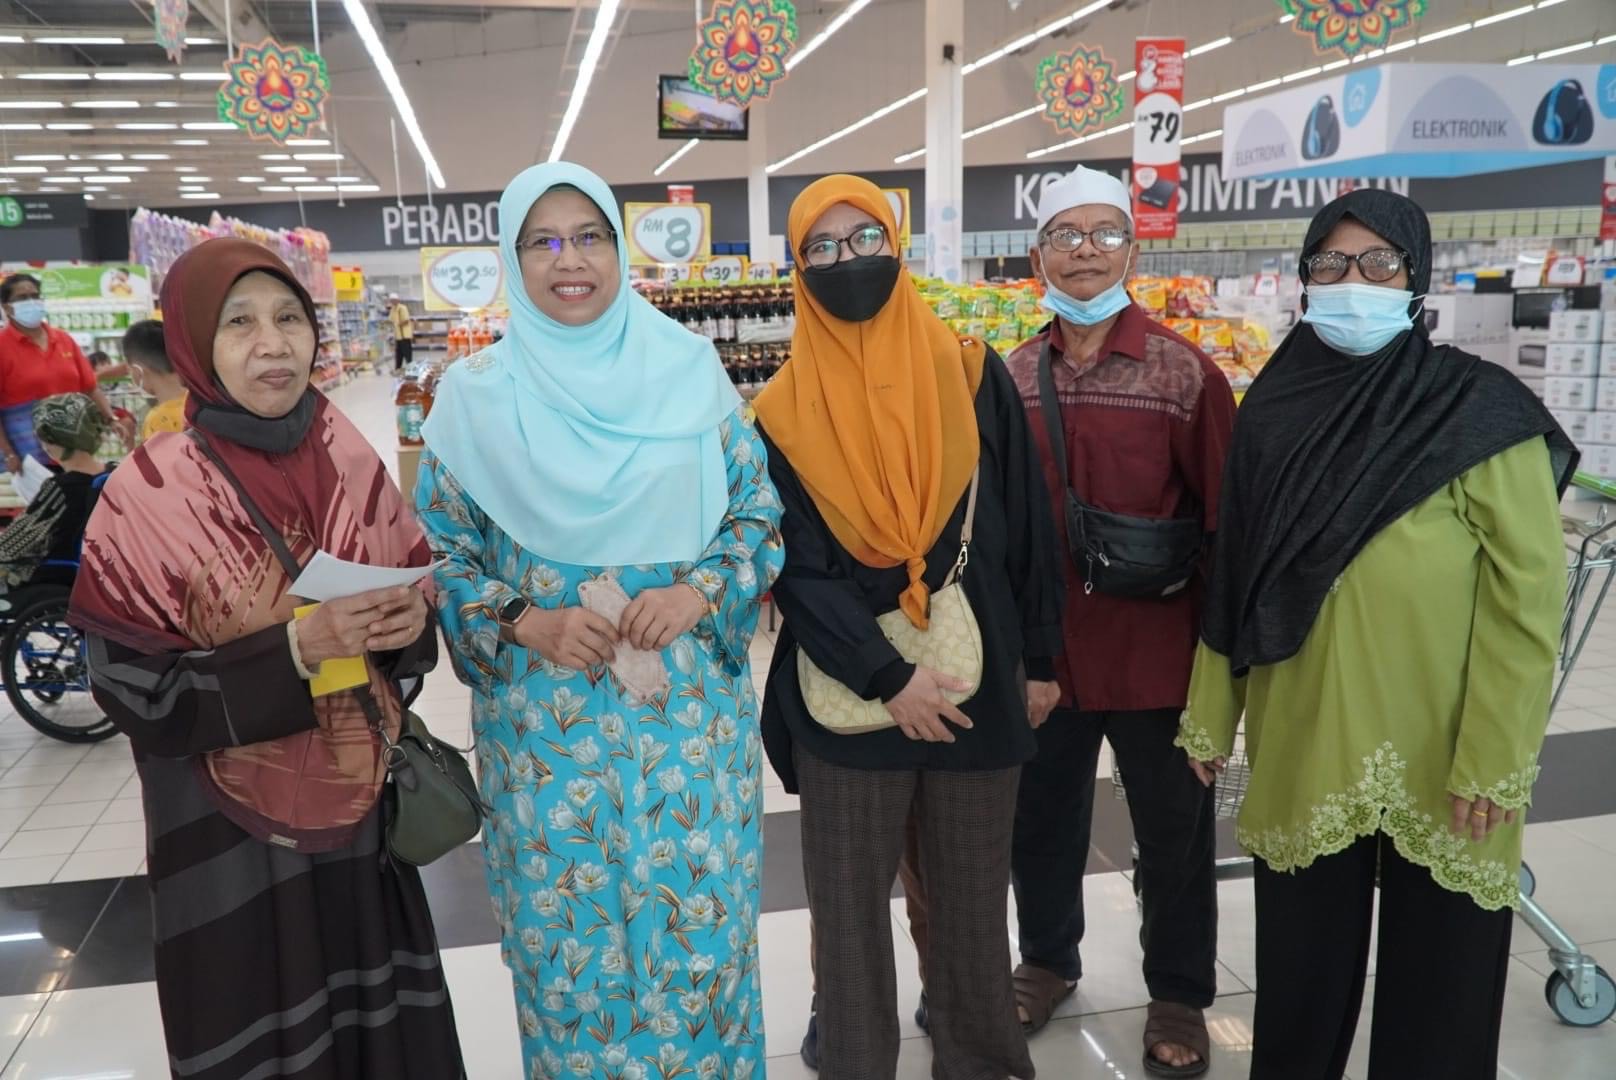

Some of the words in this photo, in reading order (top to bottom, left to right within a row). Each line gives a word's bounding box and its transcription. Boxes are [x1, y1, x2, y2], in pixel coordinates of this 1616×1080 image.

[1150, 111, 1180, 144] 79
[1412, 119, 1508, 139] ELEKTRONIK
[642, 218, 664, 233] RM
[665, 217, 692, 258] 8
